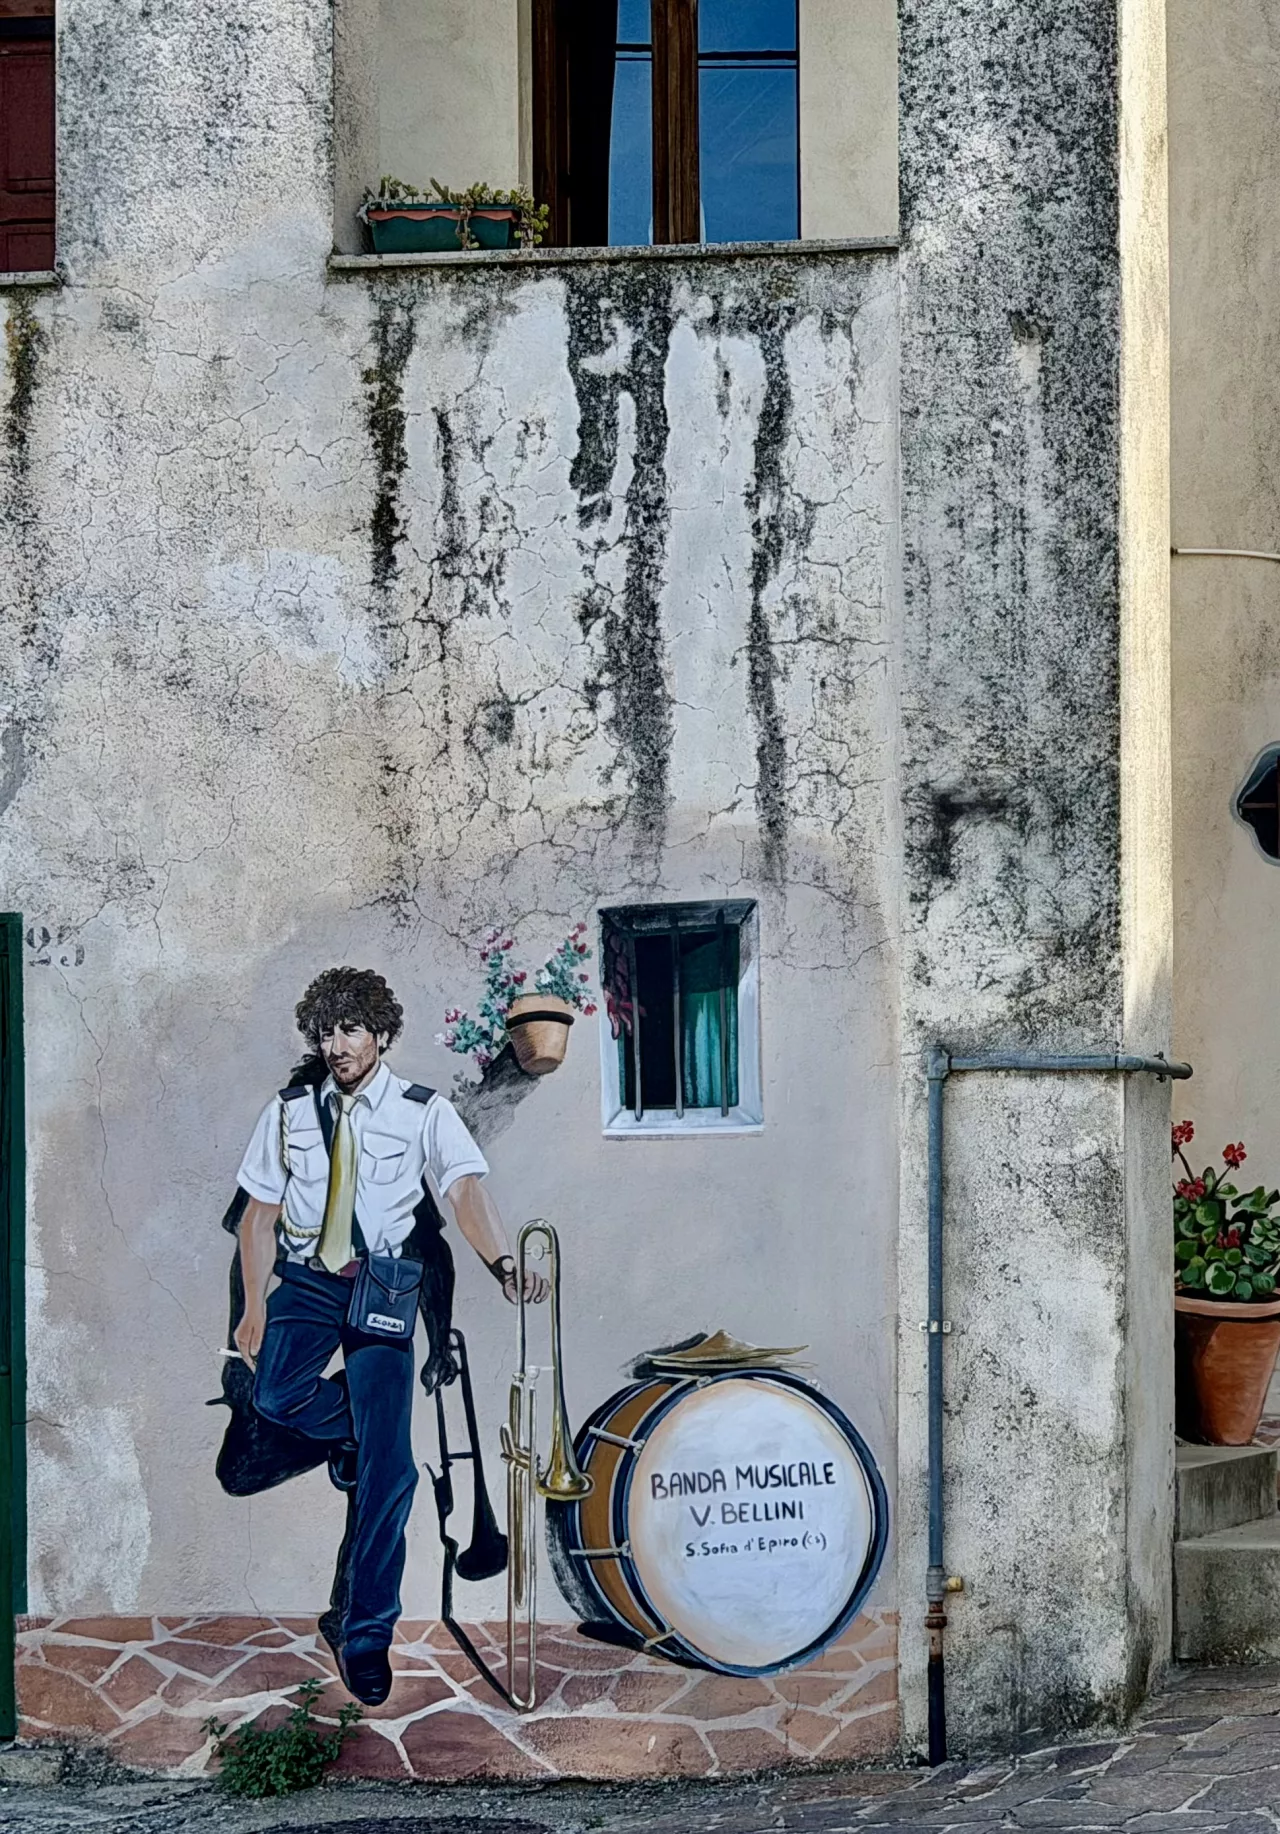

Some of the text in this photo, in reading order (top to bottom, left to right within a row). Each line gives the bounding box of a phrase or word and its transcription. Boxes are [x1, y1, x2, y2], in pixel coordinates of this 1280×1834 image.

[650, 1462, 836, 1500] BANDA MUSICALE
[689, 1500, 804, 1527] V. BELLINI
[744, 1536, 798, 1553] d'Epiro
